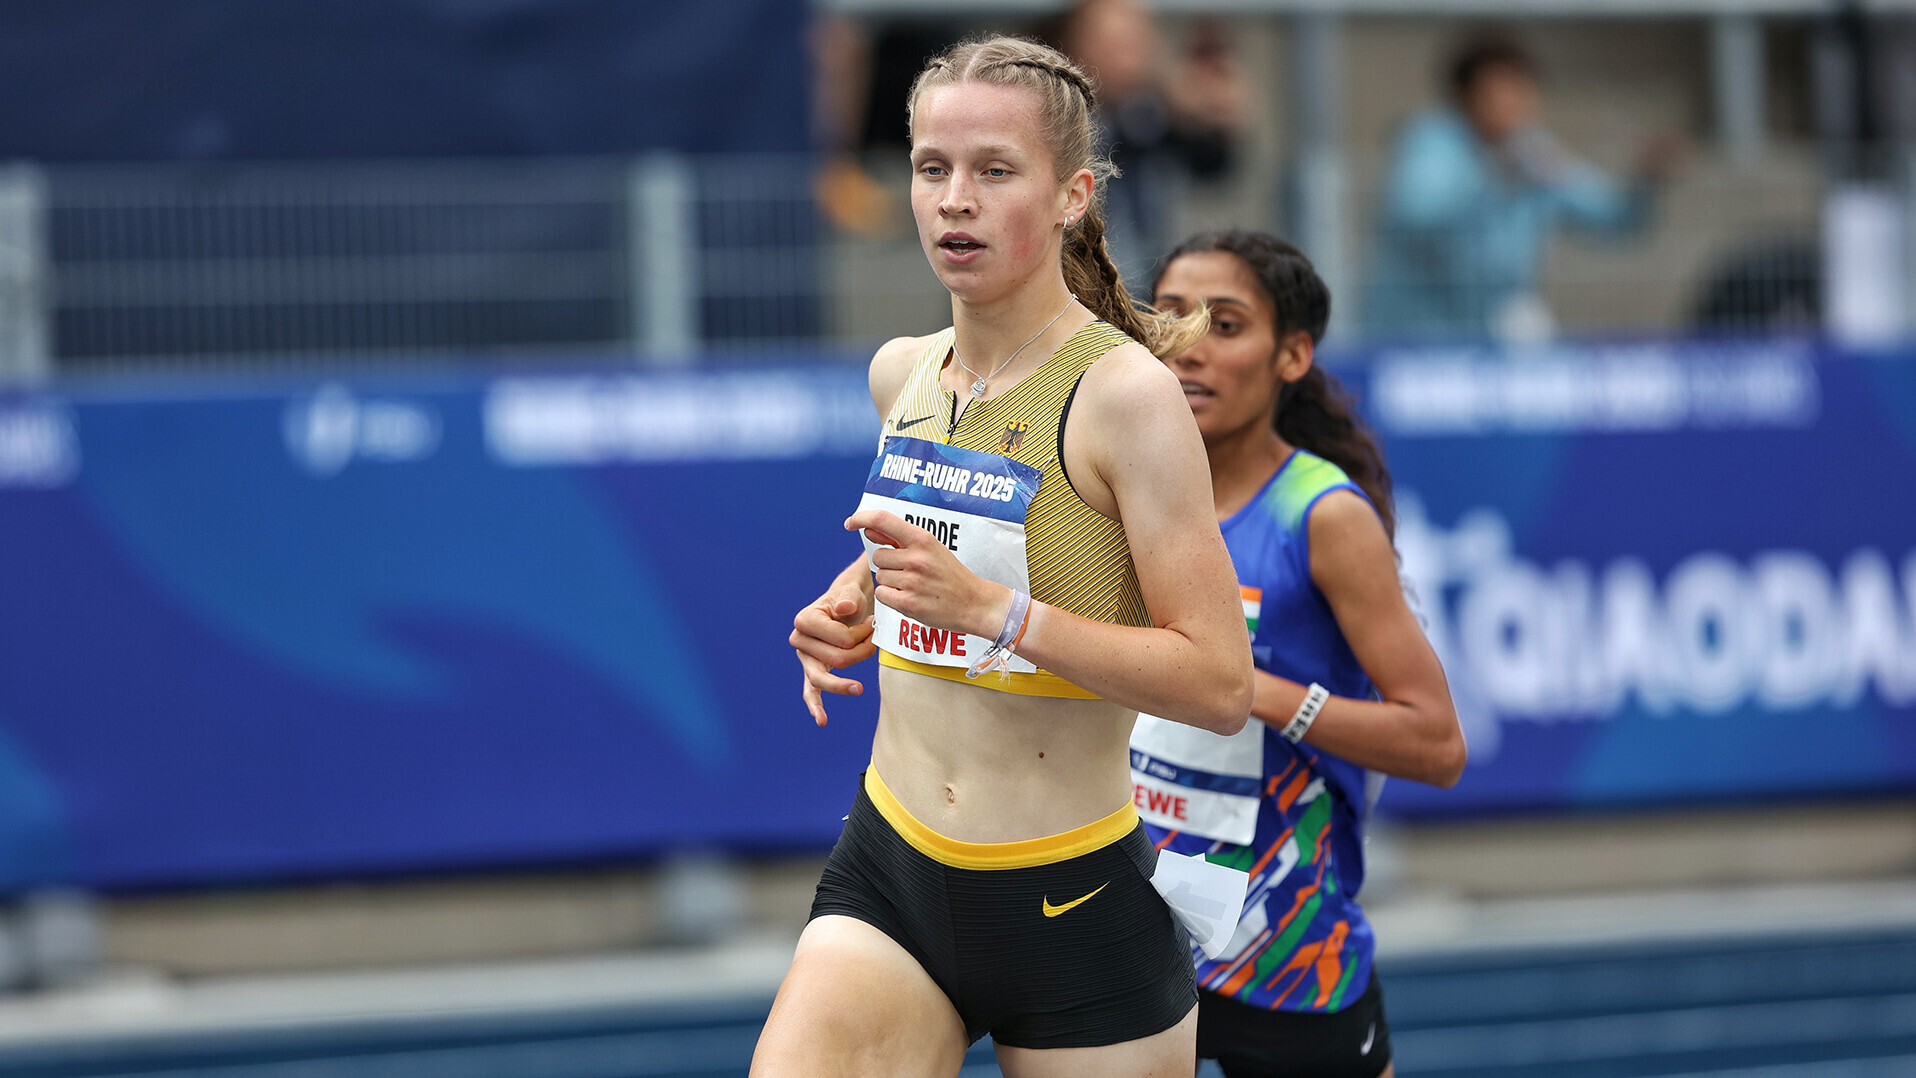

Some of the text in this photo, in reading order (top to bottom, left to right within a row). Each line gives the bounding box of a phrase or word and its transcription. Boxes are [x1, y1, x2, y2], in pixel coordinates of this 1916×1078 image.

[880, 453, 1017, 503] RHINE-RUHR 2025
[898, 618, 967, 657] REWE
[1462, 550, 1916, 720] QIAODA
[1132, 784, 1188, 822] EWE
